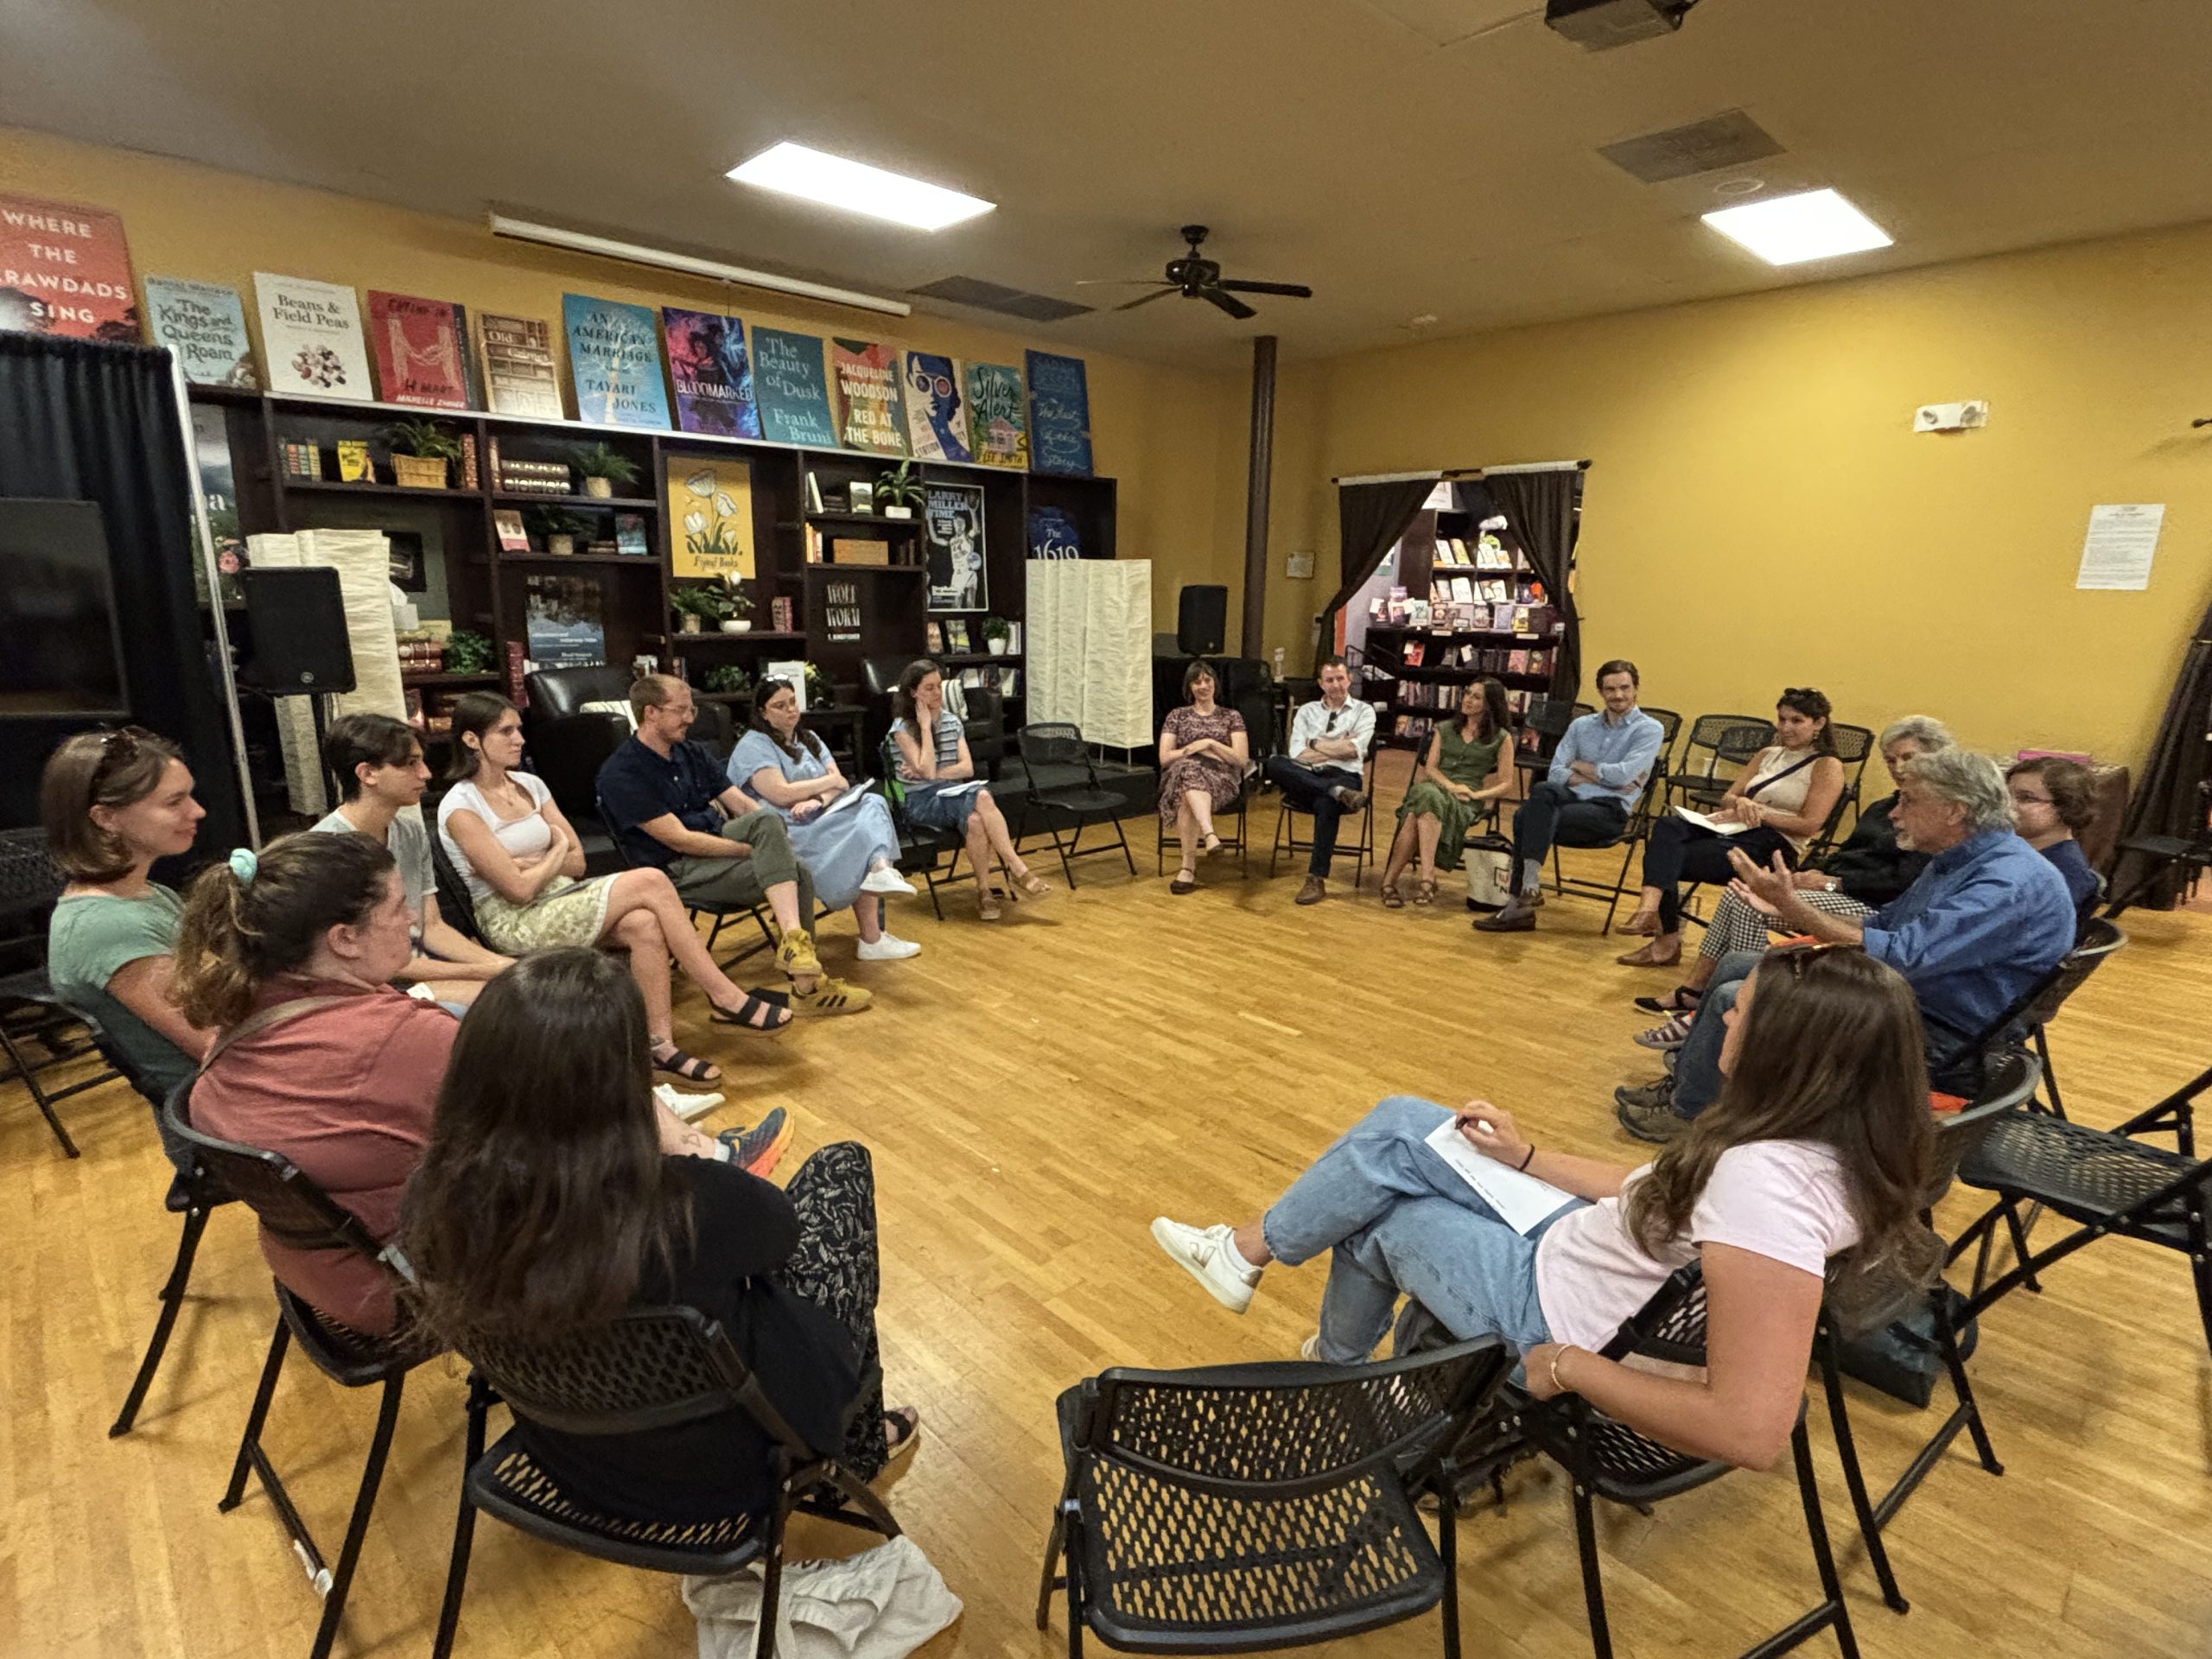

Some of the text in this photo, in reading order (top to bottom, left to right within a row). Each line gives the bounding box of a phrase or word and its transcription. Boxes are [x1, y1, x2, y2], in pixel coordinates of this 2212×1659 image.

[2, 209, 92, 238] WHERE
[27, 243, 78, 264] THE
[0, 269, 128, 301] RAWDADS
[29, 301, 95, 324] SING
[175, 298, 210, 315] The
[277, 293, 340, 315] Beans &
[158, 303, 208, 330] Kings
[273, 307, 349, 329] Field Peas
[590, 312, 608, 326] AN
[162, 324, 234, 346] Queens
[573, 324, 648, 346] AMERICAN
[185, 343, 235, 363] Roam
[580, 342, 652, 363] MARRIAGE
[766, 335, 798, 358] The
[759, 351, 810, 380] Beauty
[841, 362, 894, 382] JACQUELINE
[585, 378, 636, 396] TAYARI
[677, 378, 753, 402] BLOODMARKED
[782, 380, 821, 400] Dusk
[841, 378, 898, 404] WOODSON
[973, 365, 1018, 398] Silver
[612, 397, 657, 414] JONES
[975, 397, 1019, 426] Alert
[772, 408, 820, 429] Frank
[853, 408, 876, 425] RED
[880, 412, 893, 428] AT
[788, 425, 833, 444] Bruni
[846, 427, 902, 447] THE BONE
[928, 491, 963, 501] LARRY
[928, 500, 969, 511] MILLER
